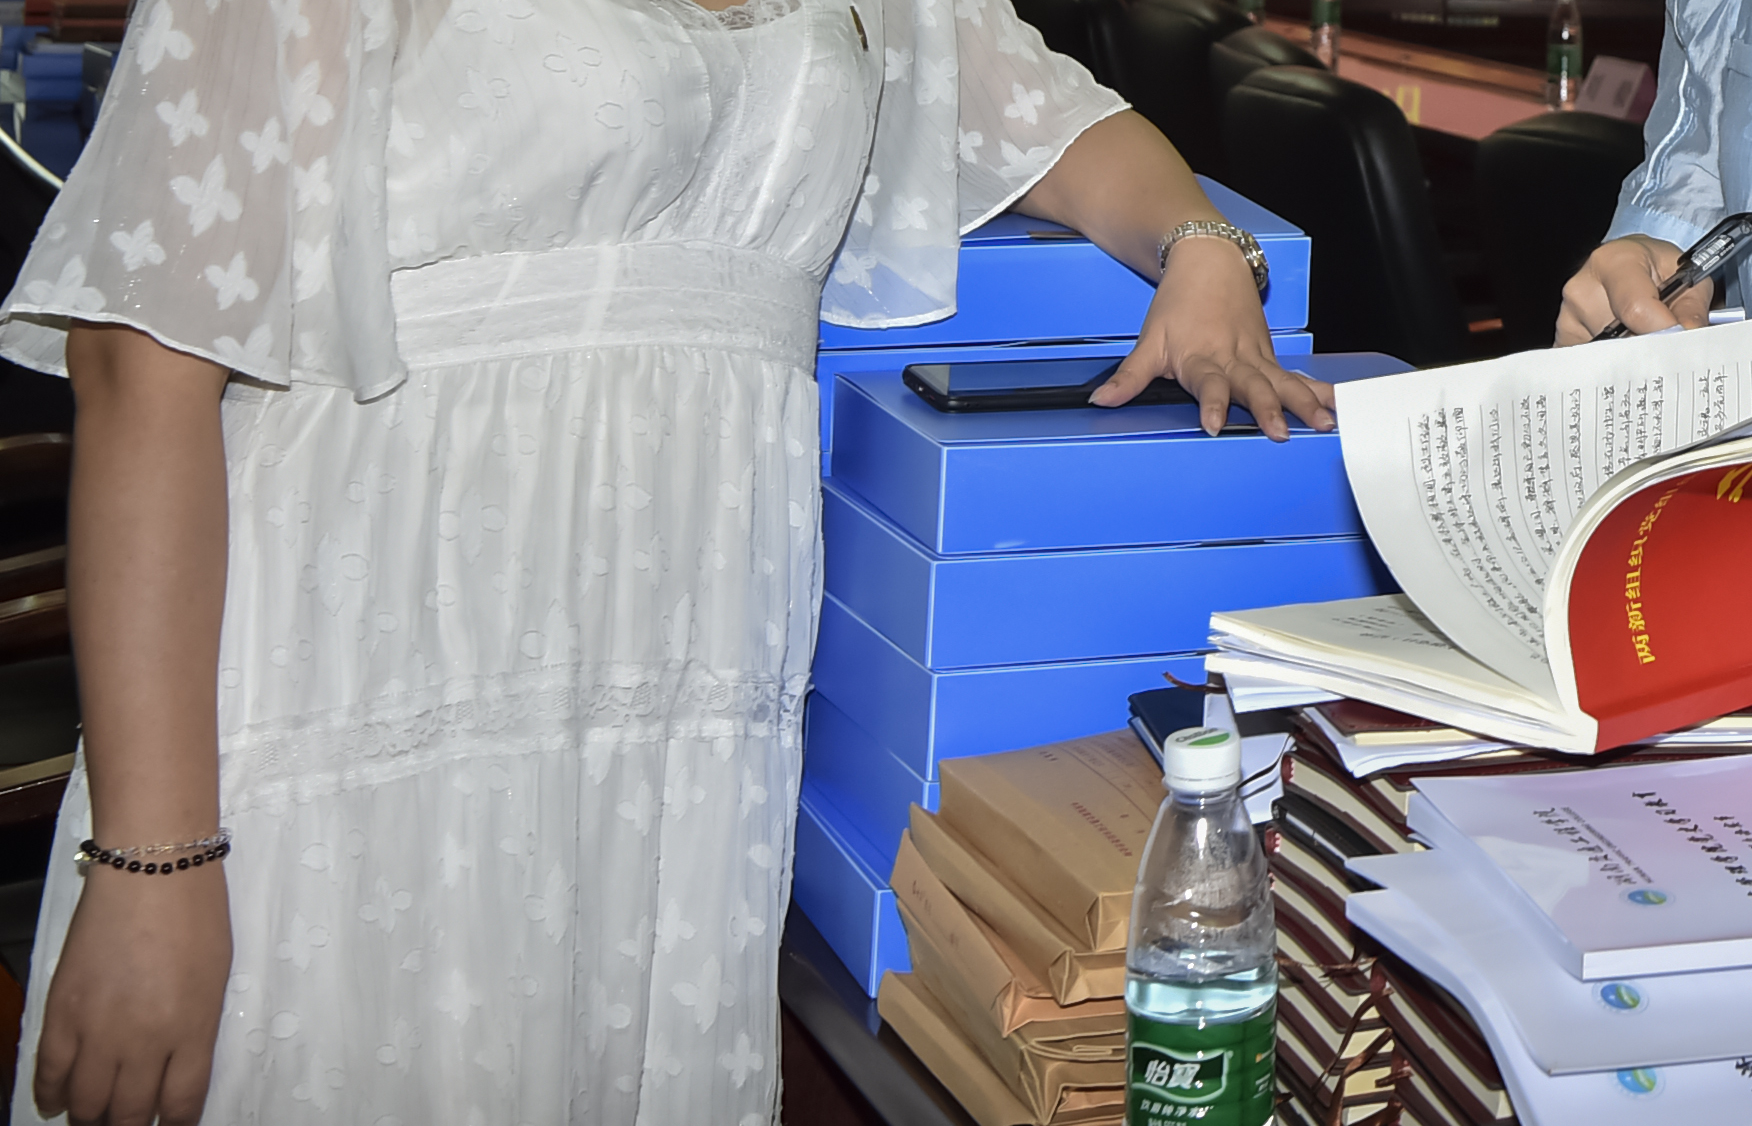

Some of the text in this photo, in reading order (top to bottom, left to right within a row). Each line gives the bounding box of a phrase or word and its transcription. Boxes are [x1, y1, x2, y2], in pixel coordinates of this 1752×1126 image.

[1624, 480, 1690, 664] 两新组织党组
[1533, 807, 1637, 885] 湖南交通工程学院
